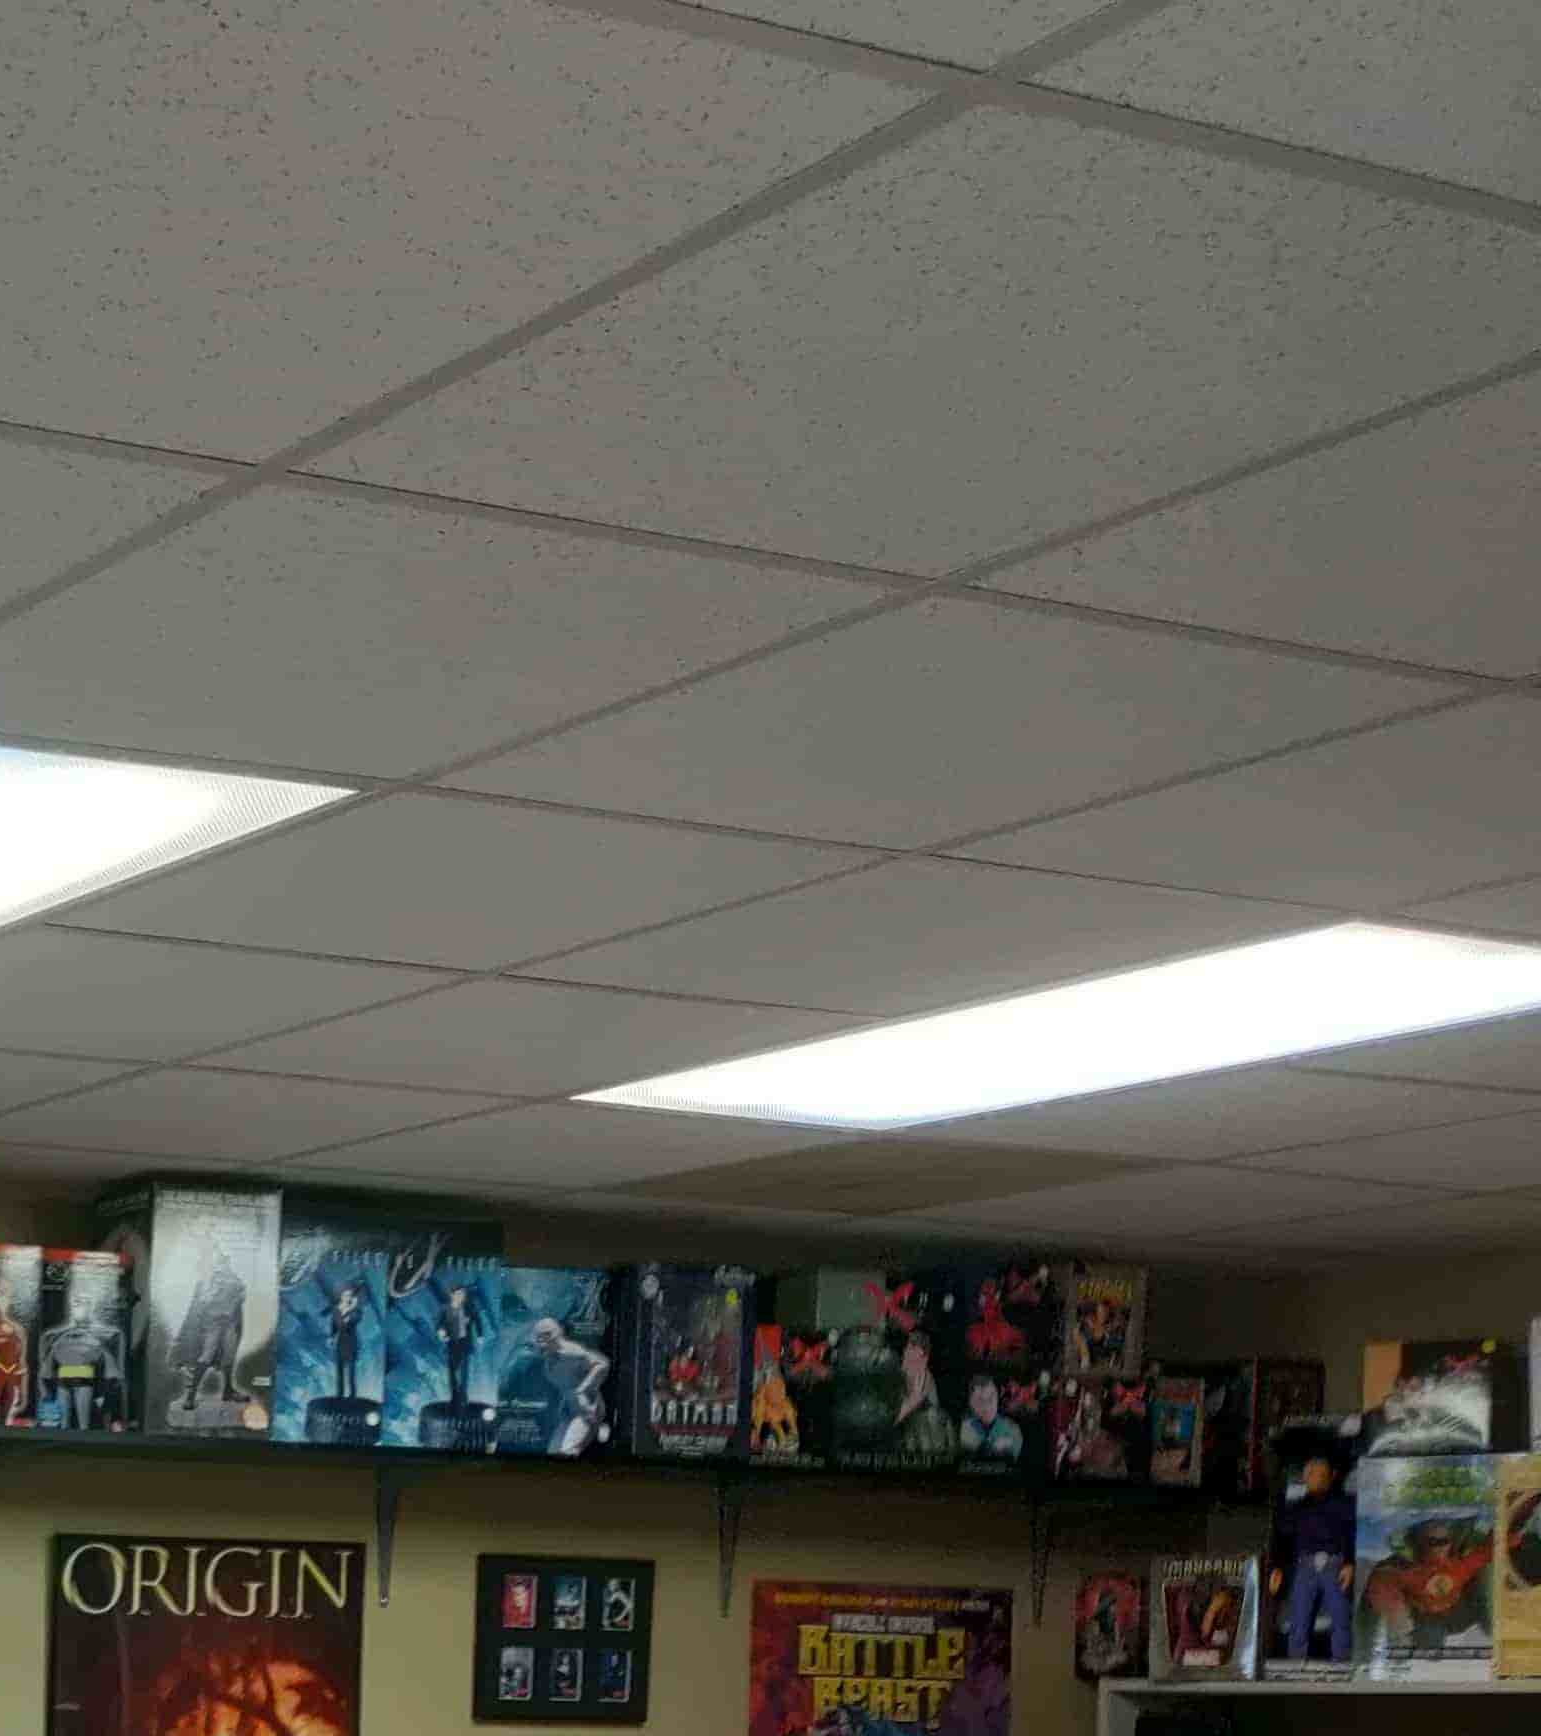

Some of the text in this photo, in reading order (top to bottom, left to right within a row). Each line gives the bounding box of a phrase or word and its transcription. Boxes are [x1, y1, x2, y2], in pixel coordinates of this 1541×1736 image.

[60, 1542, 354, 1620] ORIGIN
[797, 1624, 967, 1678] BATTLE
[813, 1676, 955, 1729] BEAST
